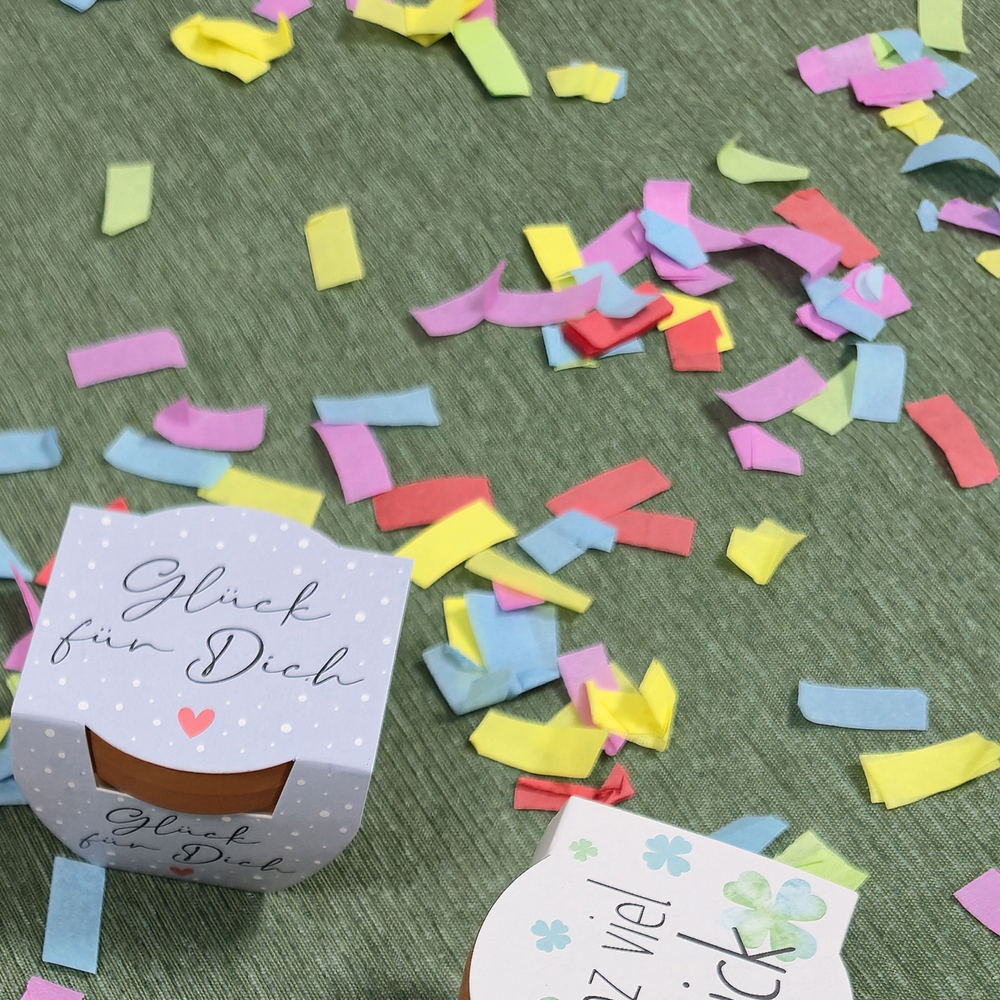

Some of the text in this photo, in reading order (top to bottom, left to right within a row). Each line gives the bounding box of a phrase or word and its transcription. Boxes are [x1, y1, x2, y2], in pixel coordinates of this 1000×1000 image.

[121, 557, 331, 626] Glück
[50, 618, 365, 686] für Dich
[79, 832, 297, 874] für Dich
[105, 807, 261, 846] Glück
[586, 878, 672, 955] viel
